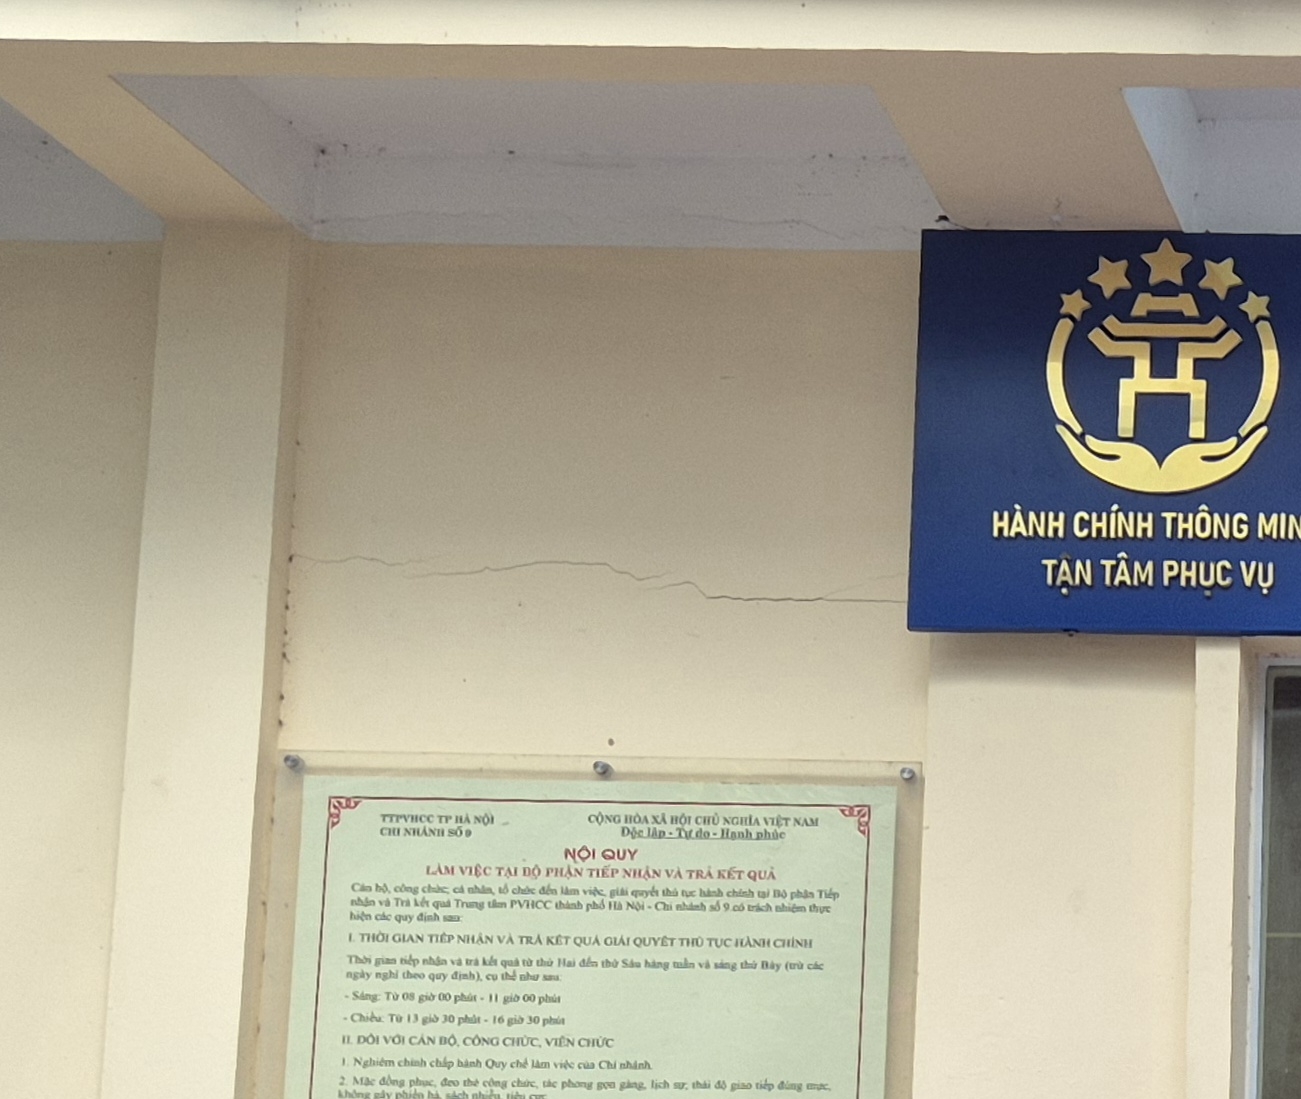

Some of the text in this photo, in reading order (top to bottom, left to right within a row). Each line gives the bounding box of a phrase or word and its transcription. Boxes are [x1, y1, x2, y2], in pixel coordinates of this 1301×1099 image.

[992, 505, 1068, 538] HÀNH
[1072, 506, 1156, 540] CHÍNH
[1161, 506, 1251, 542] THÔNG
[1042, 552, 1276, 597] TẬN TÂM PHỤC VỤ
[436, 814, 452, 823] TP
[454, 813, 470, 824] HÀ
[473, 812, 494, 825] NỘI
[587, 811, 819, 826] CỘNG HÒA XÃ HỘI CHỦ NGHĨA VIỆT NAM
[379, 825, 471, 837] CHI NHÁNH SỐ 9
[620, 827, 643, 838] Độc
[647, 827, 665, 839] lập
[675, 828, 692, 839] Tự
[695, 828, 709, 839] do
[721, 828, 752, 839] Hạnh
[756, 829, 785, 839] phúc
[564, 845, 637, 861] NỘI QUY
[426, 863, 454, 875] LÀM
[458, 863, 491, 878] VIỆC
[495, 866, 517, 878] TẠI
[522, 864, 541, 879] BỘ
[545, 864, 583, 879] PHẬN
[586, 864, 619, 878] TIẾP
[622, 865, 661, 881] NHẬN
[664, 866, 682, 879] VÀ
[717, 866, 744, 880] KẾT
[359, 931, 388, 942] THỜI
[392, 933, 423, 943] GIAN
[456, 932, 493, 945] NHẬN
[496, 933, 514, 944] VÀ
[706, 937, 732, 948] TỤC
[734, 935, 770, 948] HÀNH
[773, 936, 812, 948] CHÍNH
[352, 990, 380, 1003] Sáng:
[401, 992, 415, 1001] 08
[418, 992, 435, 1003] giờ
[438, 992, 451, 1001] 00
[453, 992, 477, 1004] phút
[489, 993, 498, 1002] 11
[502, 993, 520, 1005] giờ
[522, 993, 536, 1002] 00
[538, 993, 561, 1005] phút
